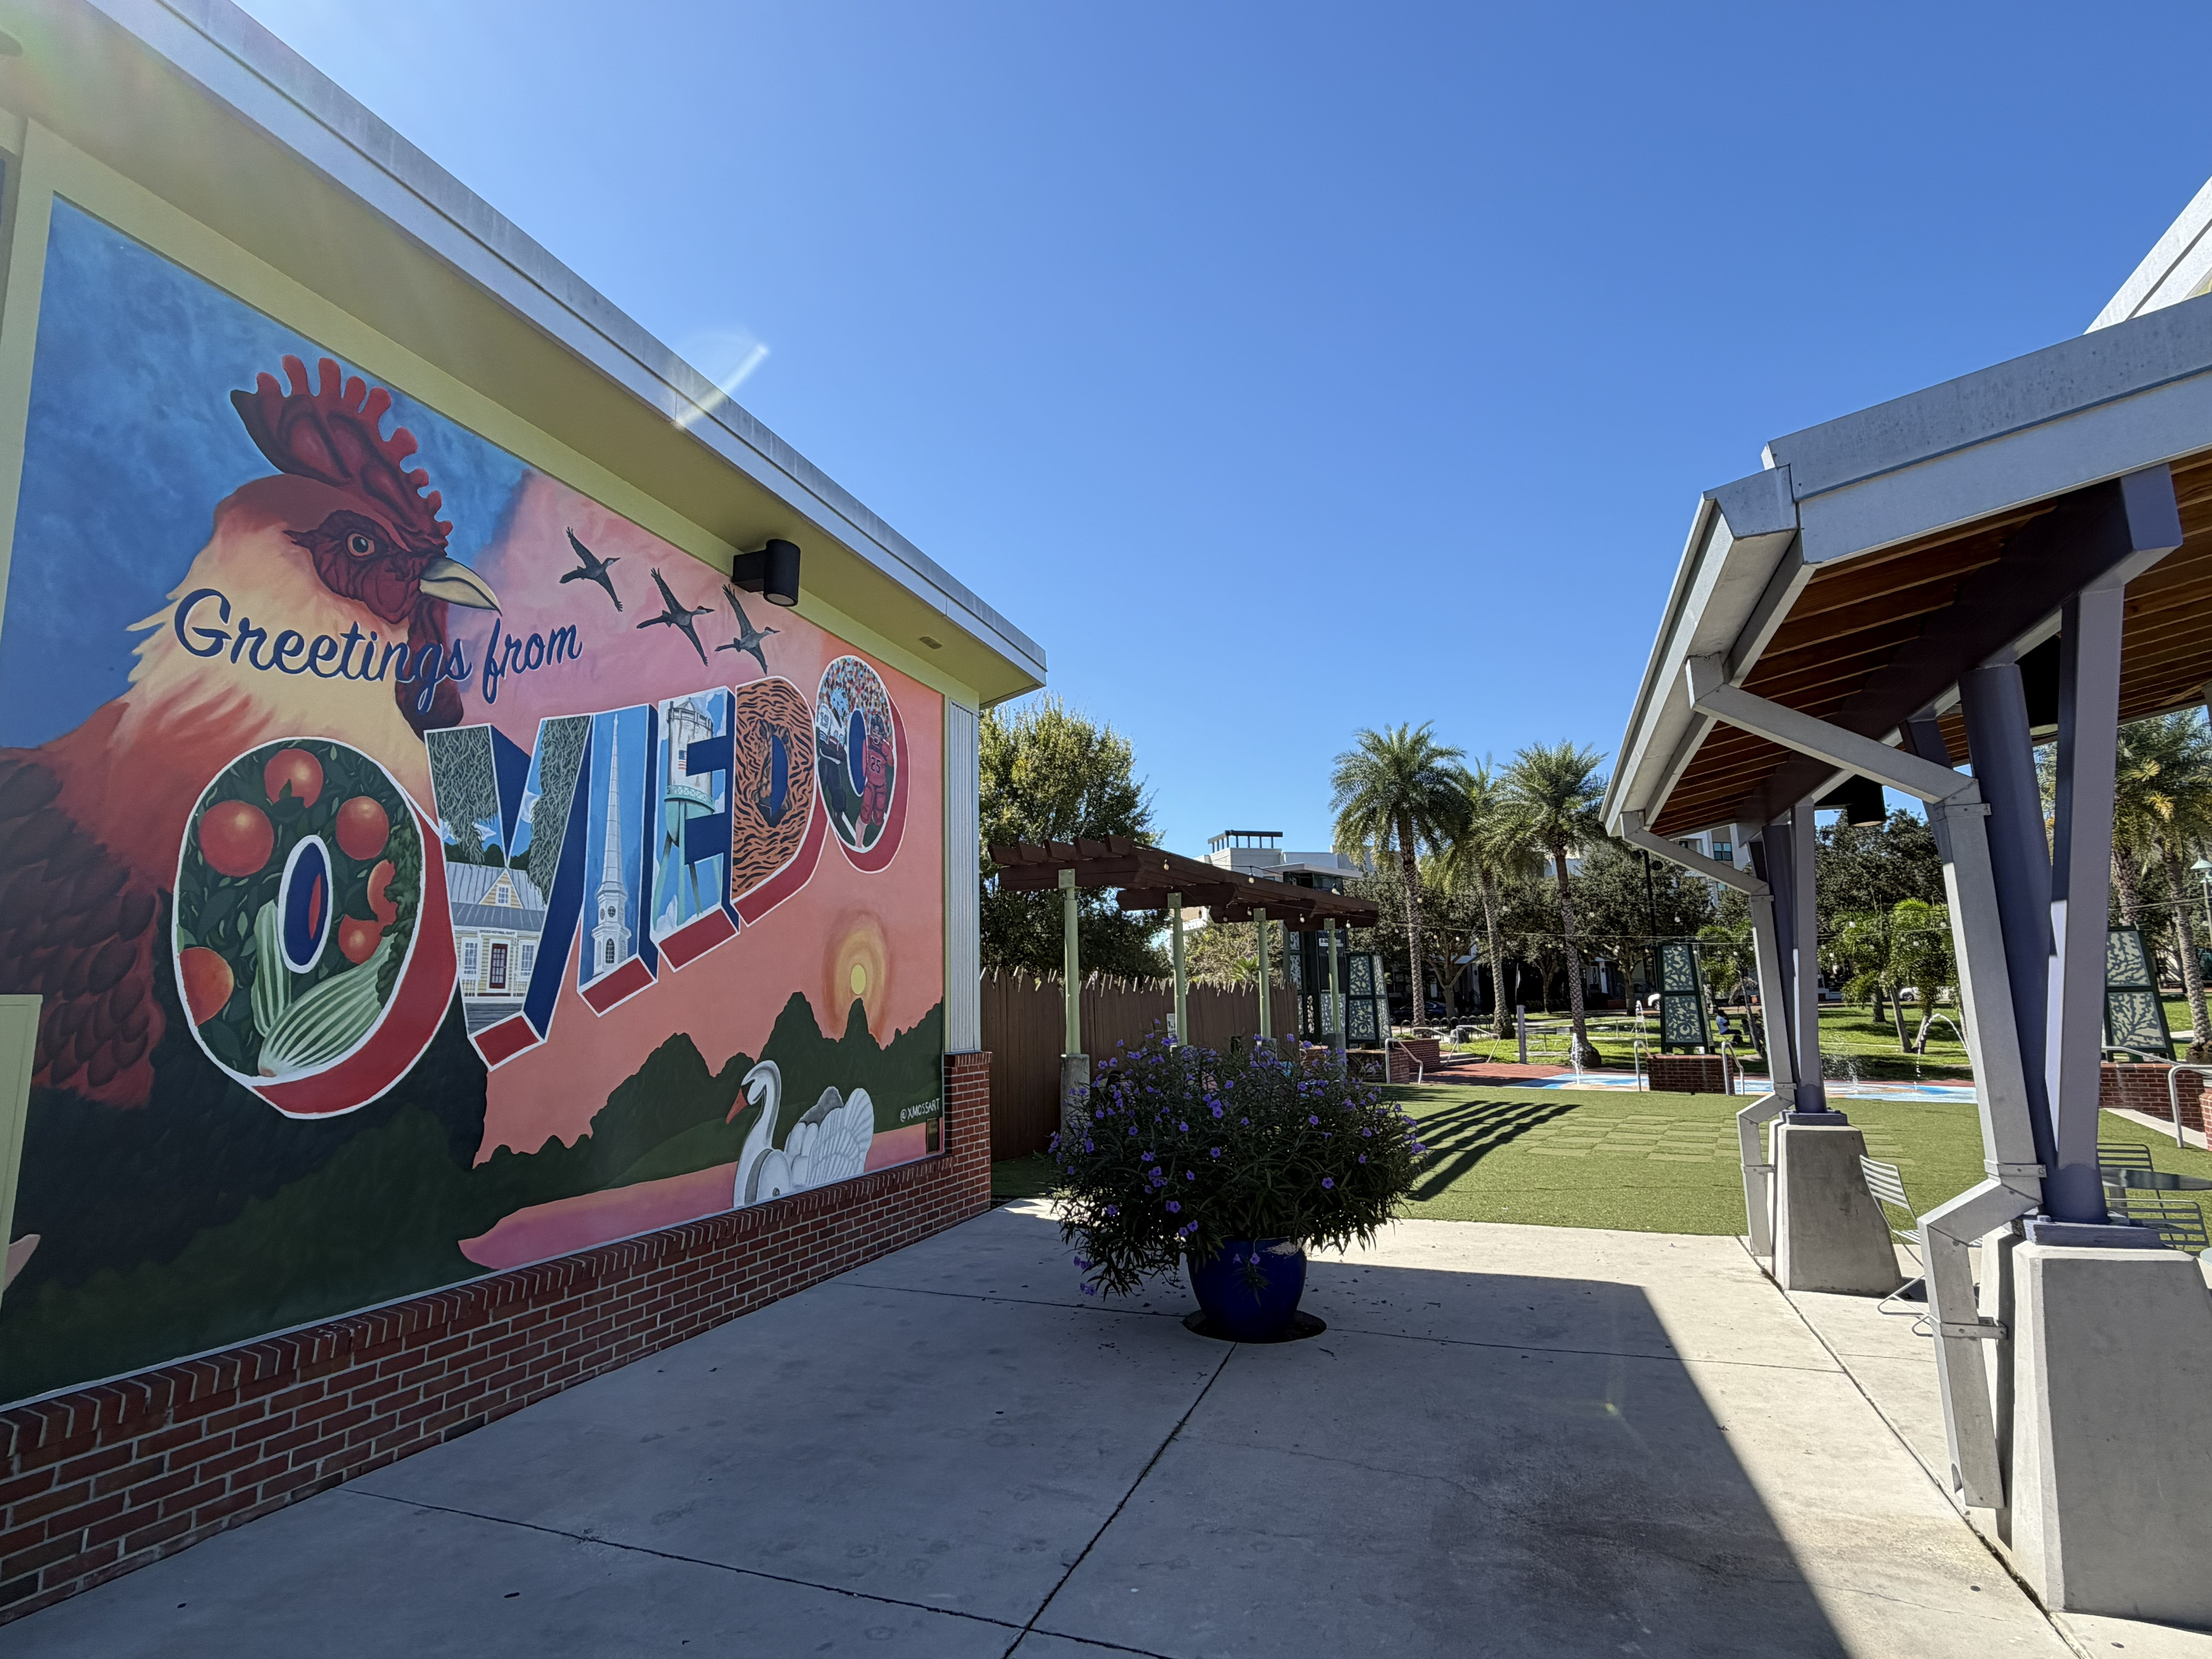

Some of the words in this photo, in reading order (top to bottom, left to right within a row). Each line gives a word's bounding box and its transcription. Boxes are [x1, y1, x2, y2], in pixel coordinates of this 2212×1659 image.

[173, 588, 473, 715] Greetings
[483, 618, 583, 705] from
[871, 755, 881, 774] 25
[171, 654, 910, 1119] OVIEDO
[900, 1097, 940, 1122] @XMOSSART
